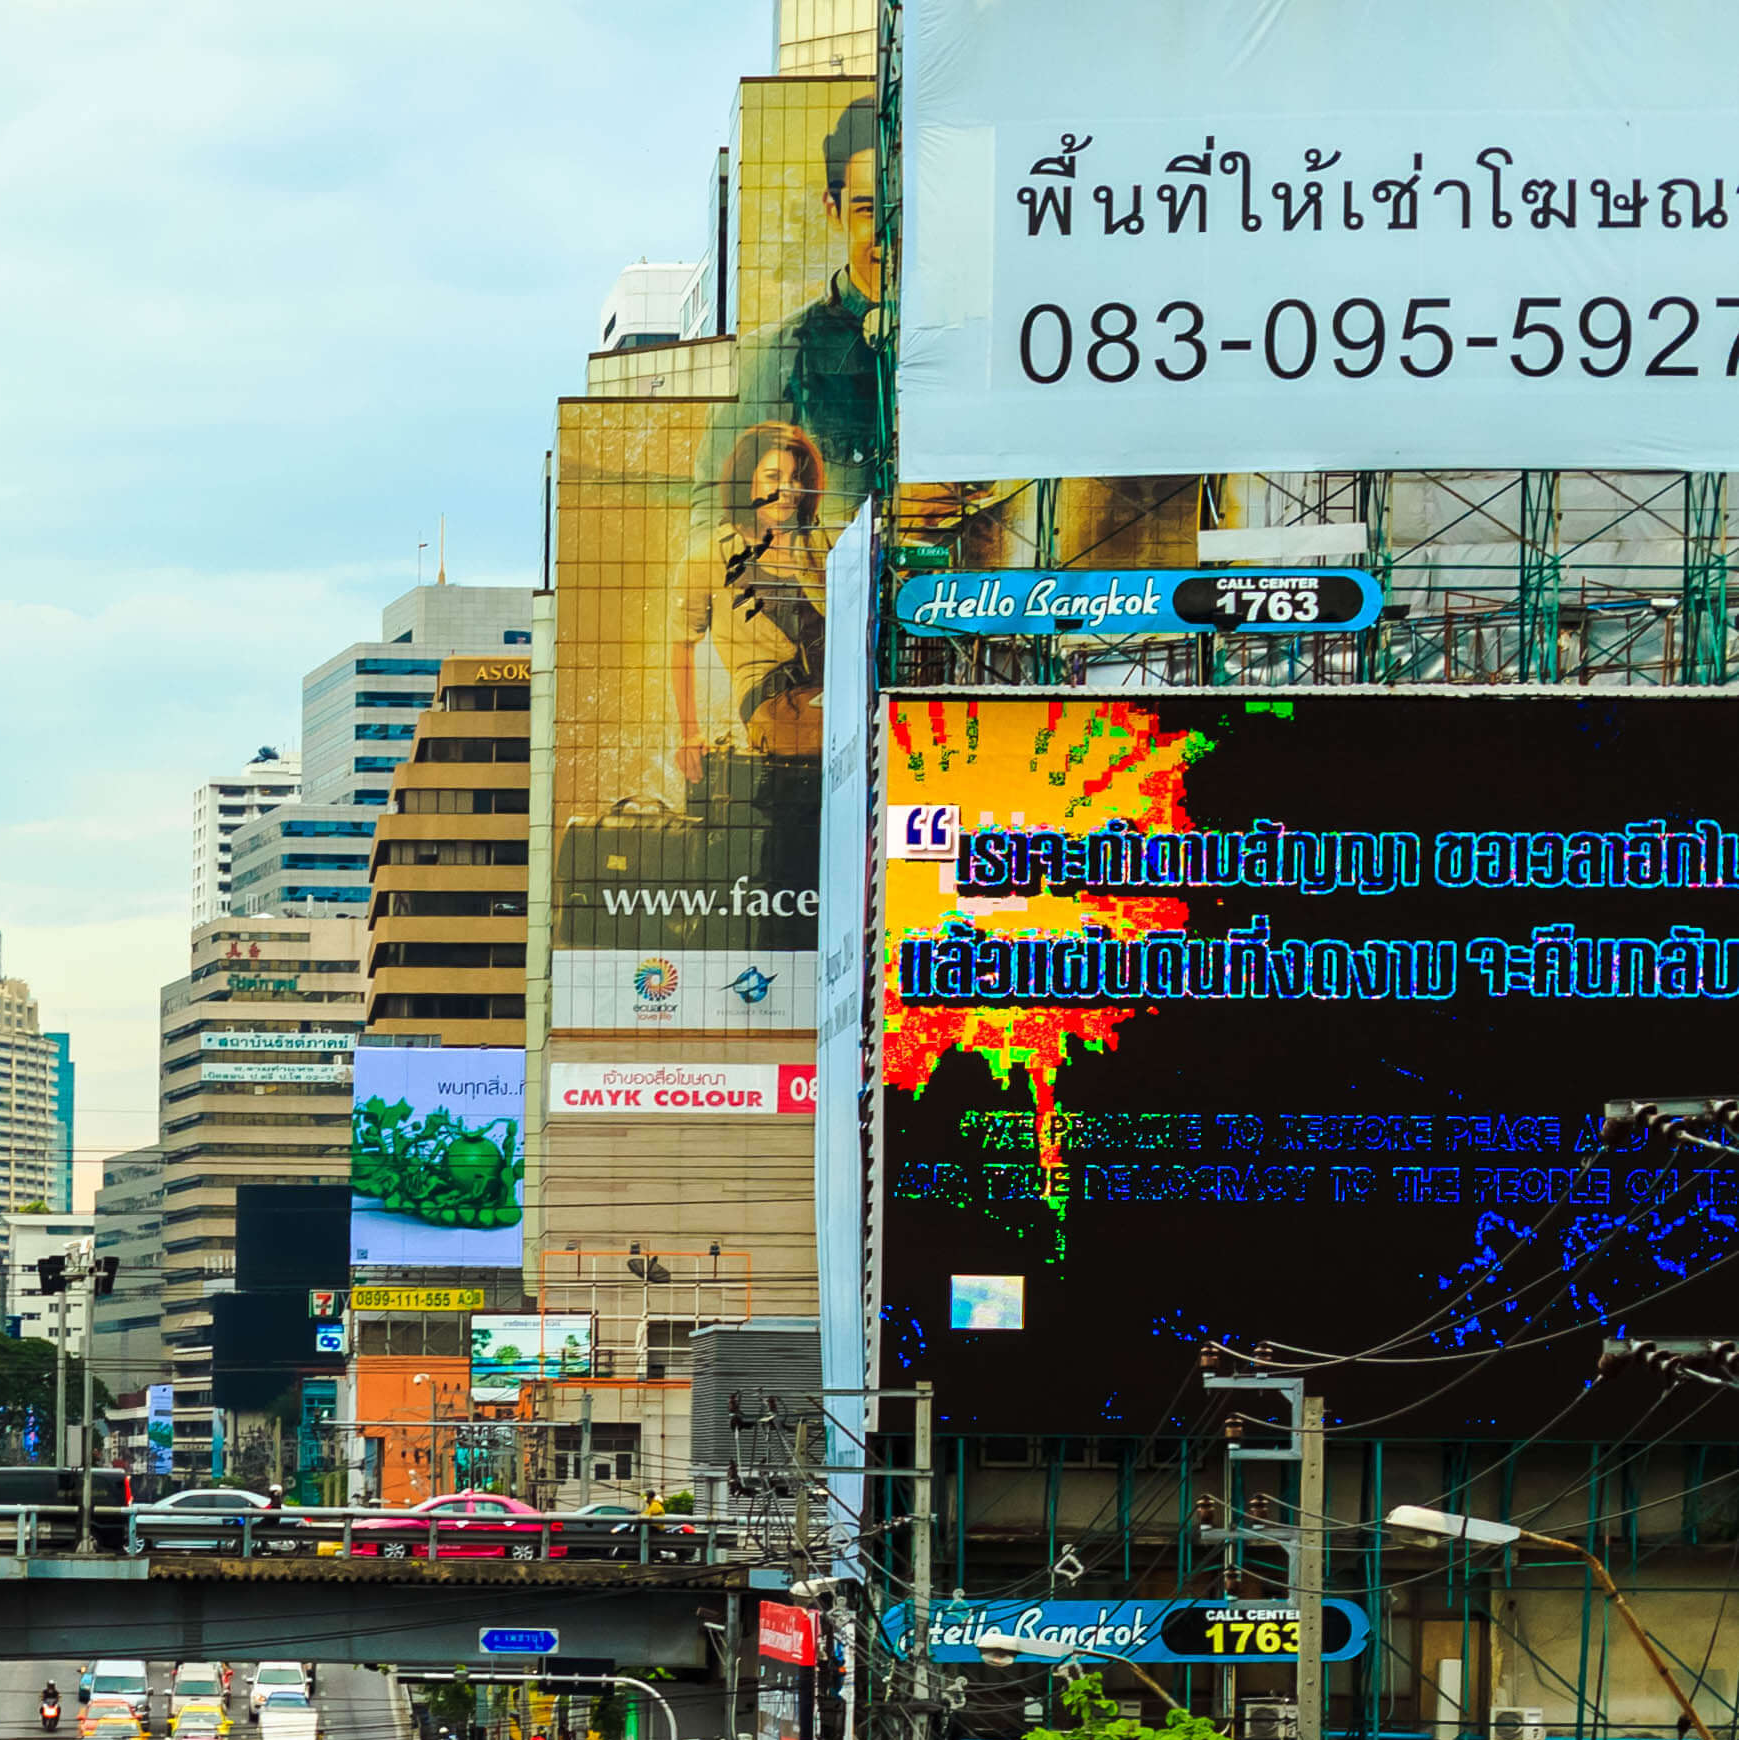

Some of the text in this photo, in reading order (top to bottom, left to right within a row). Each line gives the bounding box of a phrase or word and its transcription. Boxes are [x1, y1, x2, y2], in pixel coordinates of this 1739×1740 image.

[1017, 132, 1739, 236] พื้นที่ให้เช่าโฆษณ
[1217, 579, 1319, 589] CALL CENTER
[914, 577, 1160, 627] Hello Bangkok
[1217, 591, 1319, 622] 1763
[603, 877, 819, 917] www.face
[563, 1090, 641, 1107] CMYK
[654, 1090, 763, 1107] COLOUR
[1204, 1610, 1243, 1621] CALL
